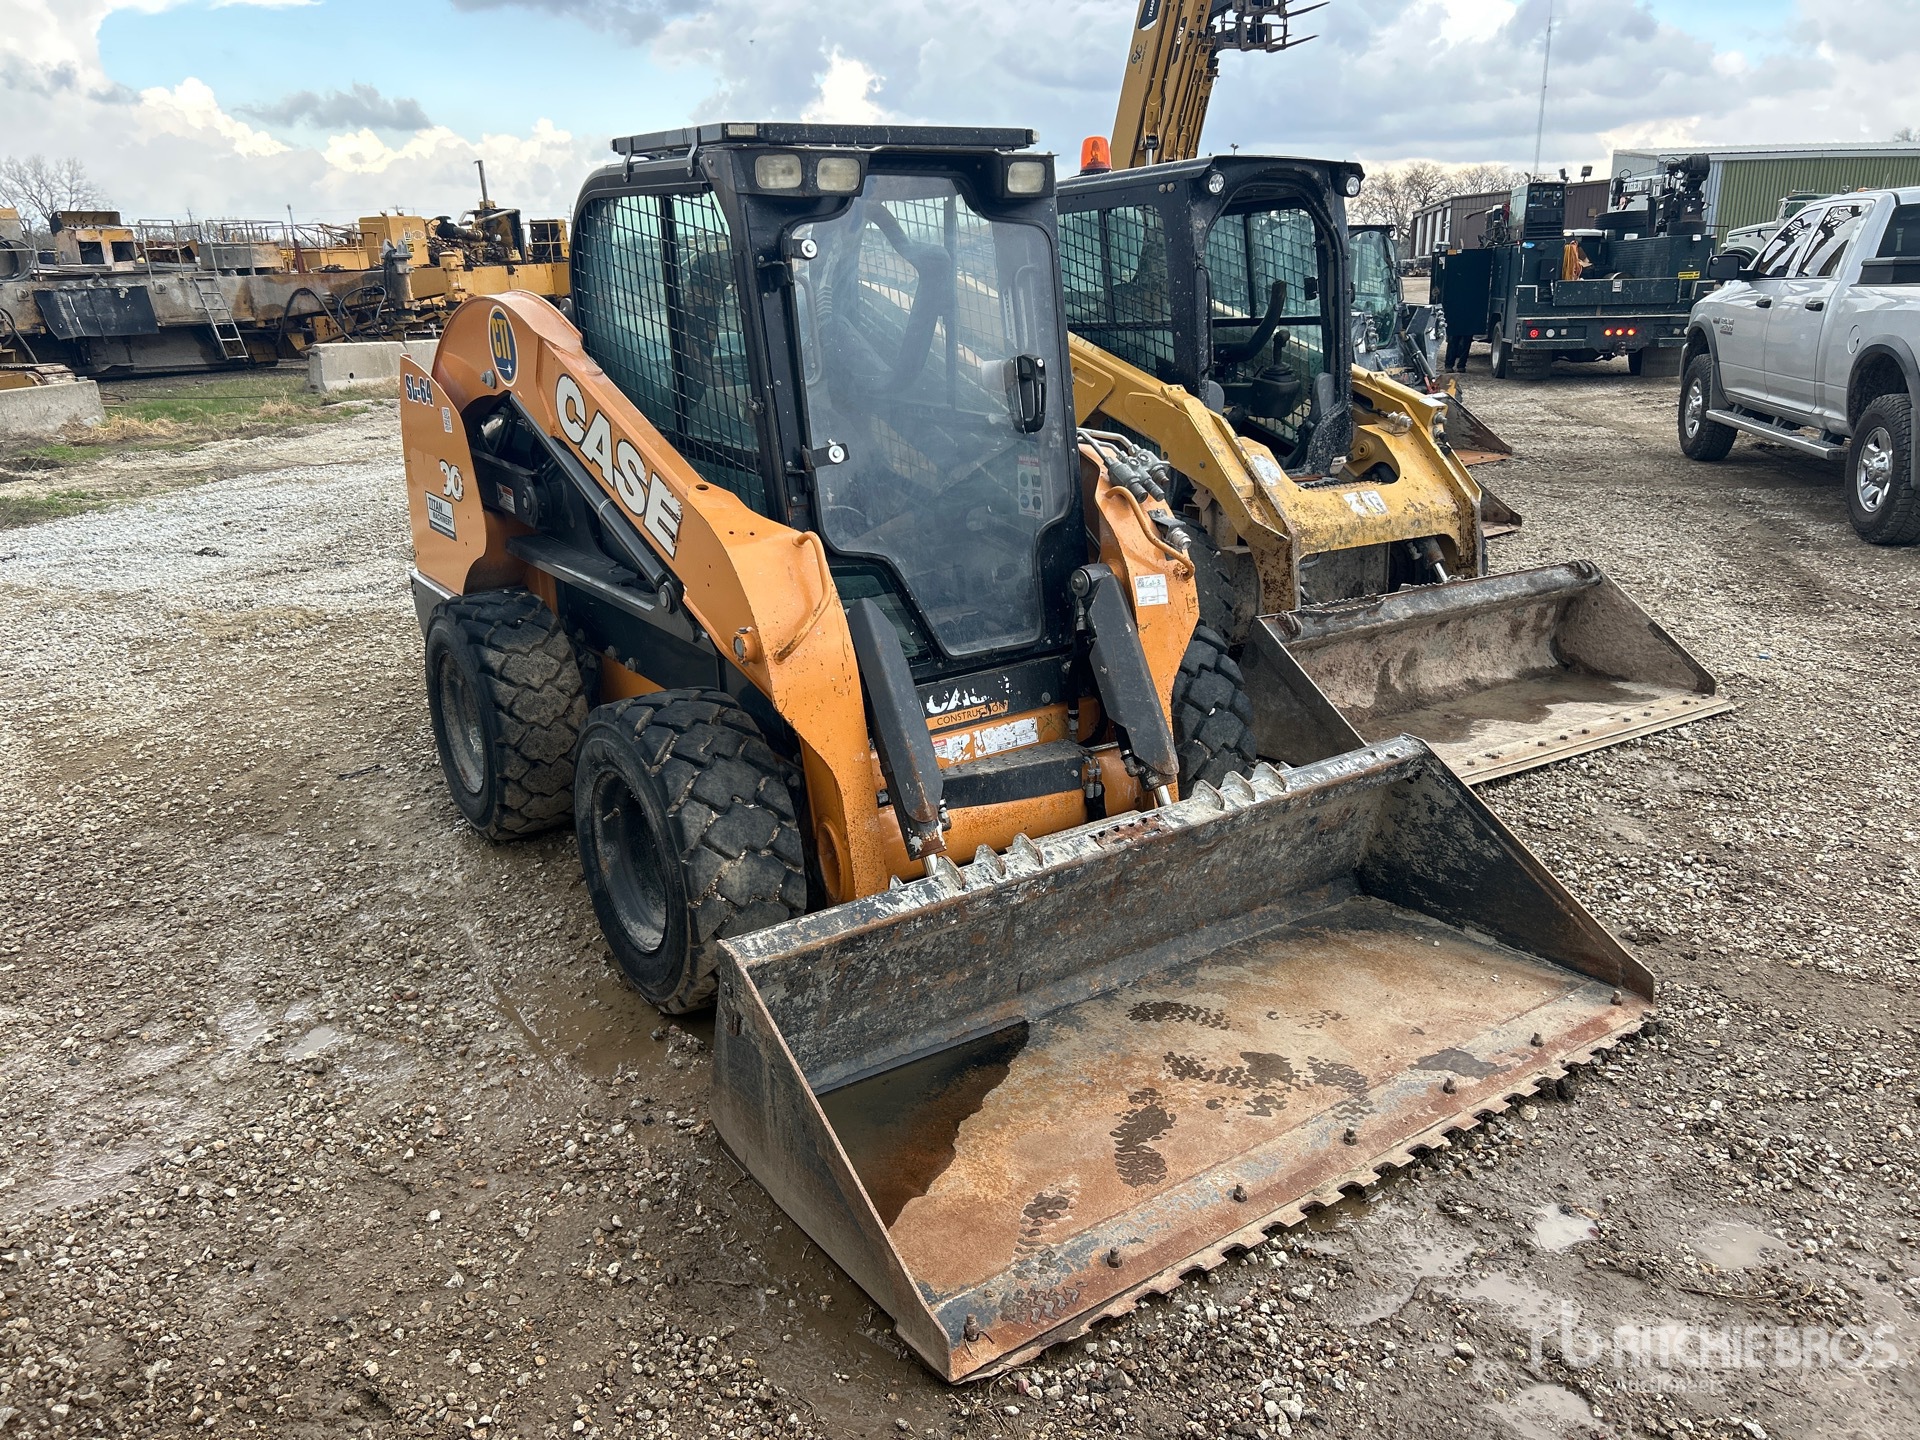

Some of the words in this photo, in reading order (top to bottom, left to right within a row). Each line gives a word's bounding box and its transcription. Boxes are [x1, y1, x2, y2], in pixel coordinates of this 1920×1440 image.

[491, 316, 512, 361] CTI
[405, 373, 434, 407] SL-64
[556, 374, 683, 559] CASE
[428, 497, 443, 512] TITAN
[432, 511, 453, 526] MACHINERY
[936, 700, 1006, 726] CONSTRUCON
